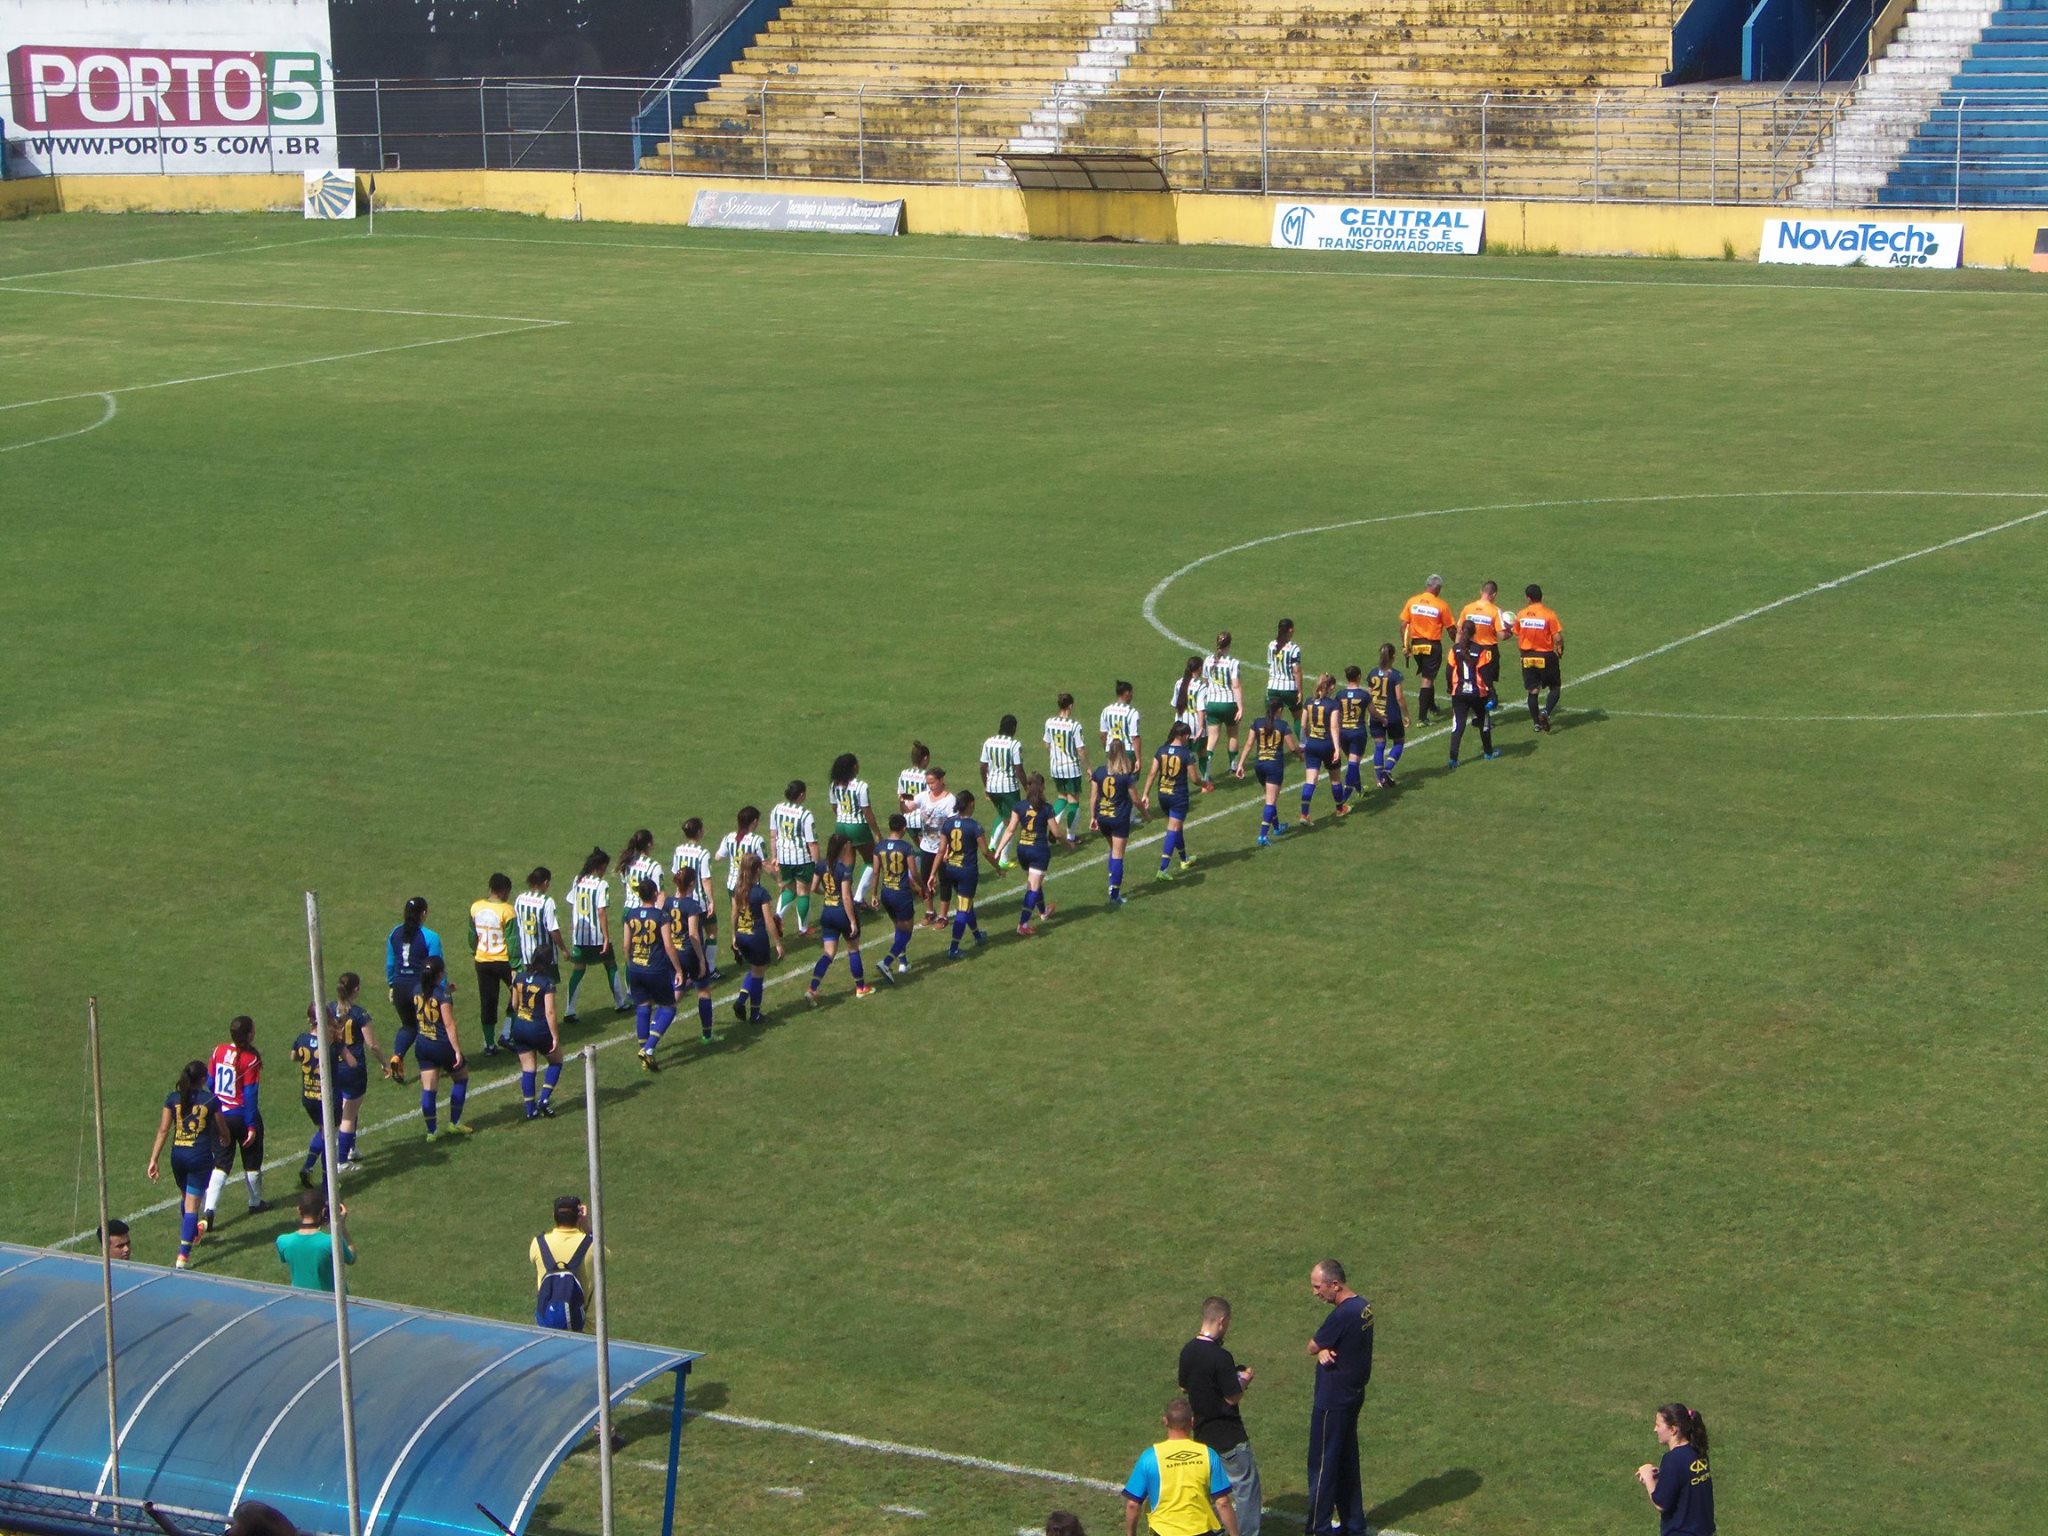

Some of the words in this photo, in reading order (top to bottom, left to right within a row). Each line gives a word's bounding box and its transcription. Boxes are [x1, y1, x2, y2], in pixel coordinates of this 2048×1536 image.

[1340, 207, 1469, 229] CENTRAL
[1318, 237, 1464, 252] TRANSFORMADORES
[1348, 227, 1430, 241] MOTORES
[1442, 229, 1452, 240] E
[1778, 221, 1925, 253] NovaTech
[1370, 675, 1389, 698] 21
[1161, 754, 1182, 777] 19
[1102, 776, 1116, 799] 6
[1025, 809, 1038, 831] 7
[950, 828, 963, 852] 8
[880, 851, 904, 874] 18
[629, 917, 657, 945] 23
[516, 982, 541, 1010] 17
[217, 1066, 234, 1096] 12
[174, 1103, 209, 1134] 13
